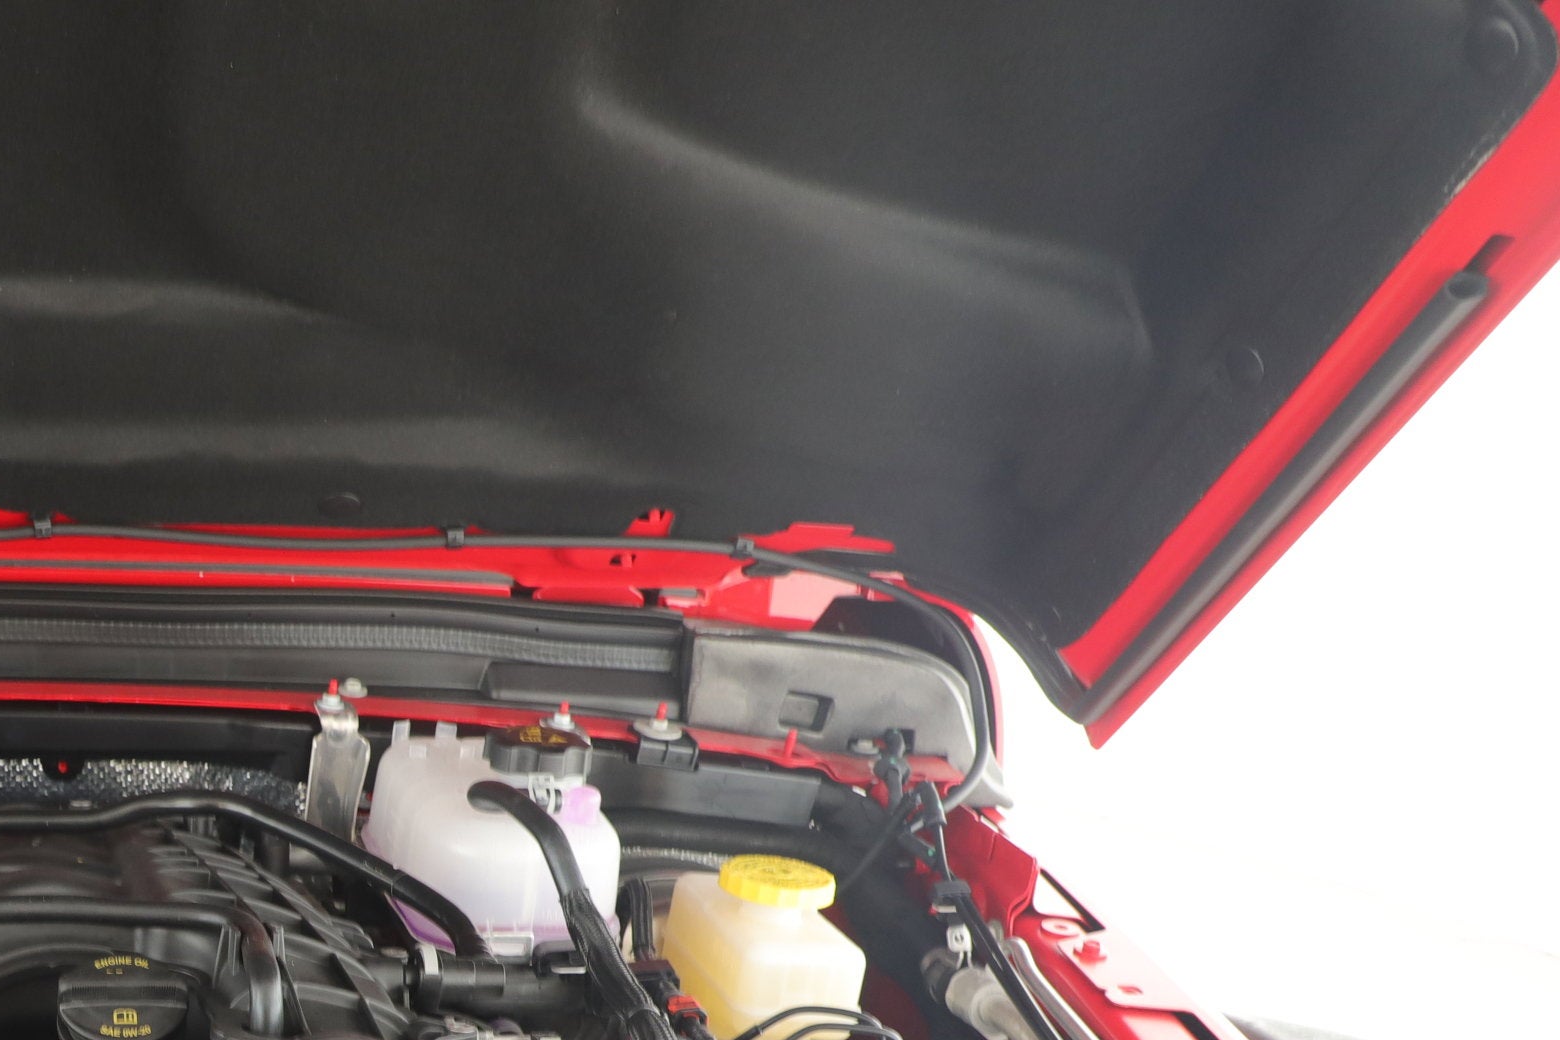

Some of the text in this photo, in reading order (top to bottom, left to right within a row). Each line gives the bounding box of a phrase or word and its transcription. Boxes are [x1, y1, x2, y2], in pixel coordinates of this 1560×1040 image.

[94, 955, 150, 970] ENGINE OIL
[100, 1024, 152, 1038] SAE 0W-20
